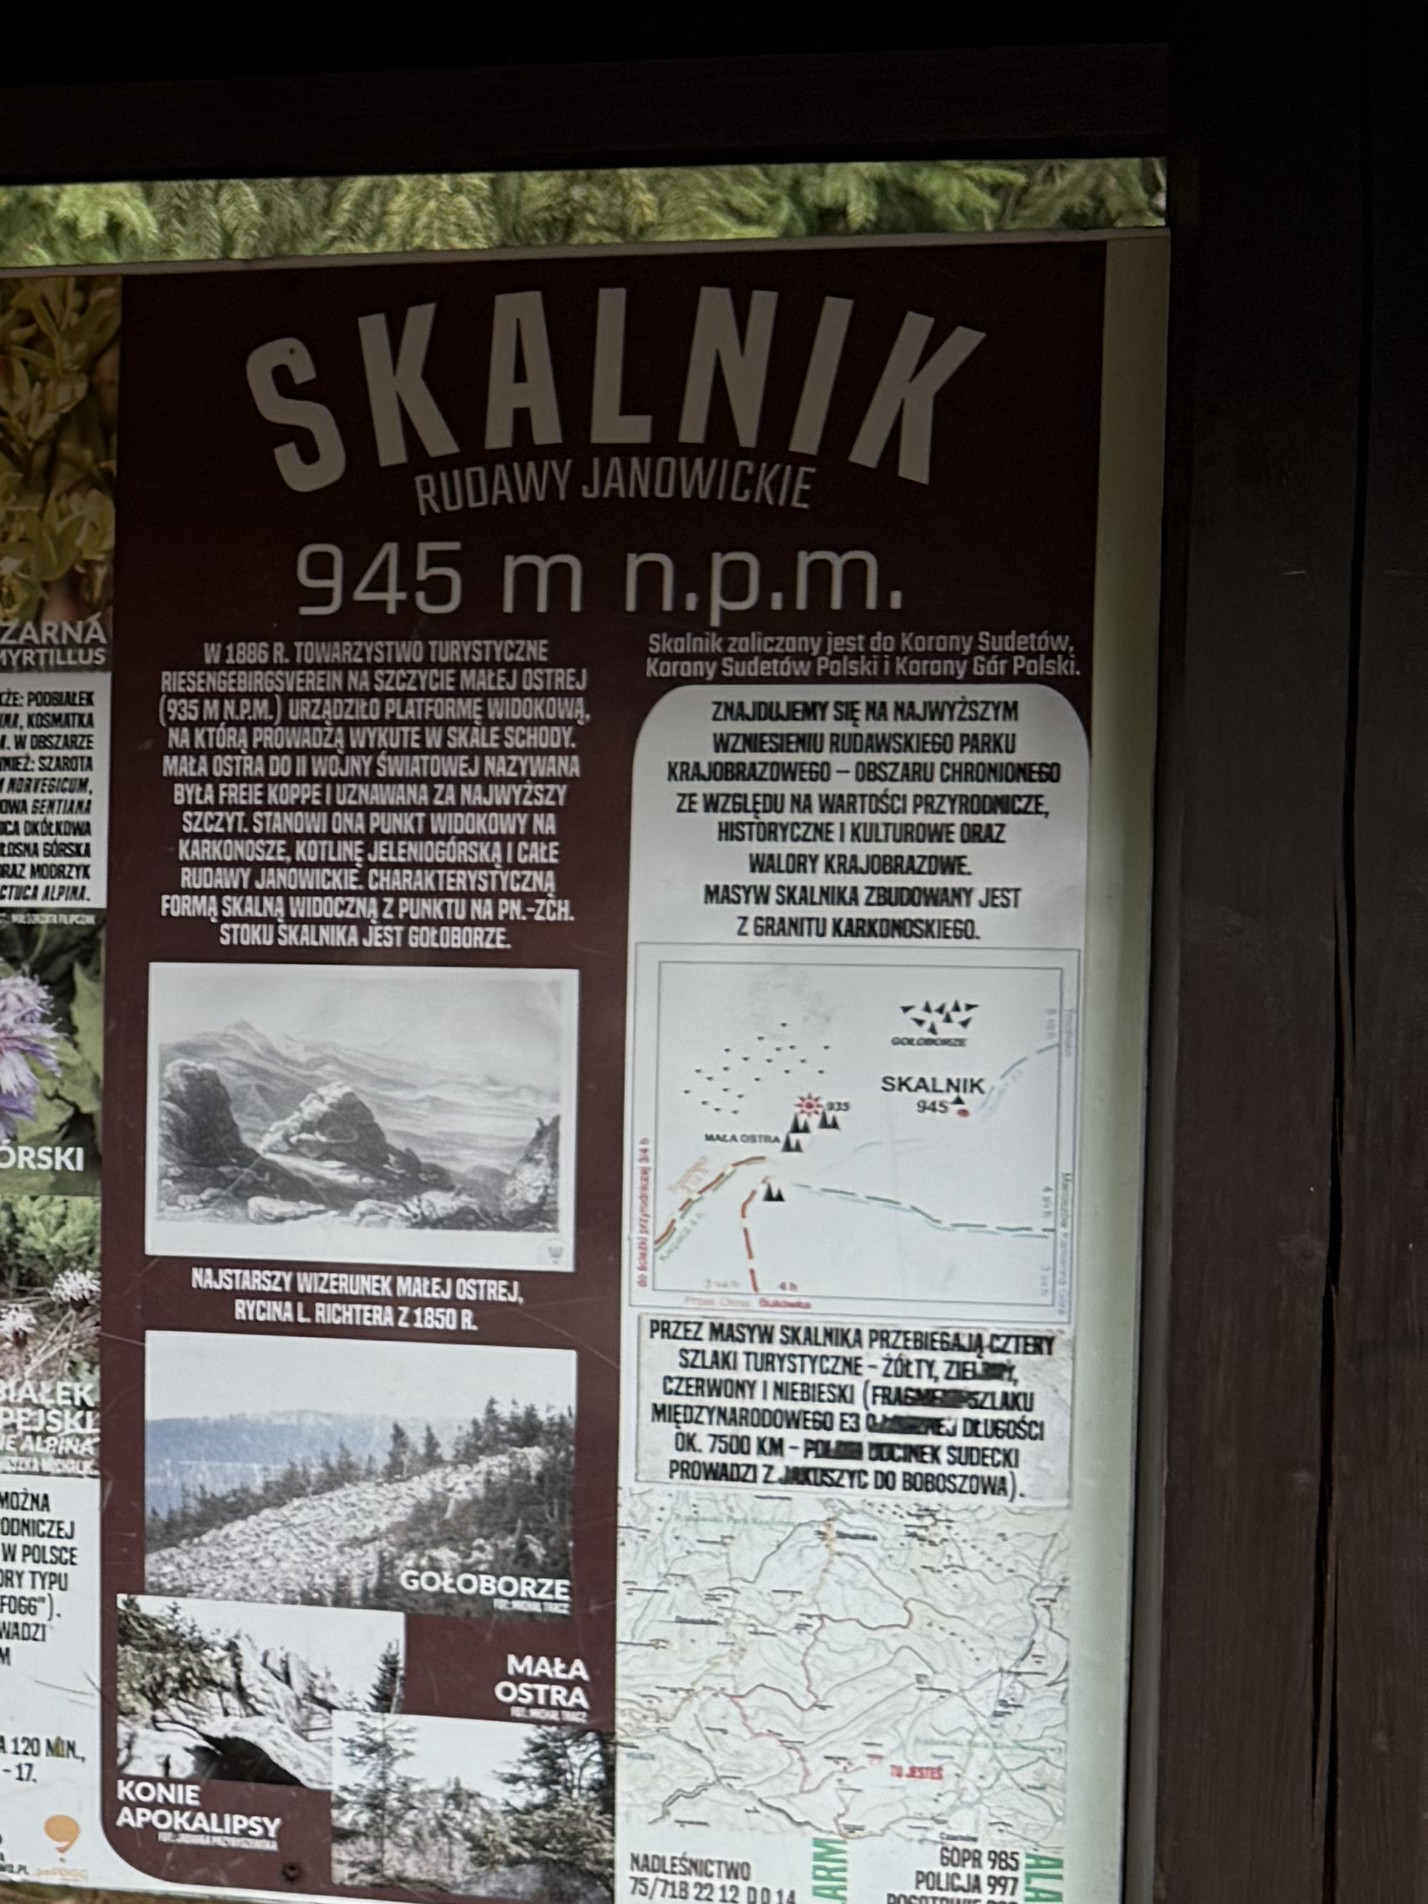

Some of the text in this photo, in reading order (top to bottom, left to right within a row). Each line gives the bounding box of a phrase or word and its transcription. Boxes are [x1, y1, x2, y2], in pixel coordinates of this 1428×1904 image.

[246, 286, 987, 493] SKALNIK
[414, 456, 816, 516] RUDAWY JANOWICKIE
[297, 540, 902, 627] 945 m n.p.m.
[204, 640, 548, 664] W 1886 R. TOWARZYSTWO TURYSTYCZNE
[649, 633, 722, 653] Skalnik
[727, 633, 820, 656] zaliczany
[826, 633, 864, 655] jest
[870, 632, 895, 652] do
[978, 632, 1074, 651] Sudetów,
[722, 657, 810, 677] Sudetów
[817, 657, 878, 676] Polski
[884, 657, 889, 676] i
[973, 656, 1006, 676] Gór
[1014, 656, 1080, 675] Polski.
[162, 669, 587, 692] RIESENGEBIRGSVEREIN NA SZCZYCIE MAŁEJ OSTREJ
[160, 695, 589, 725] (935 M N.P.M.) URZĄDZIŁO PLATFORMĘ WIDOKOWĄ,
[712, 697, 1018, 726] ZNAJDUJEMY SIĘ NA NAJWYŻSZYM
[713, 734, 1016, 753] WZNIESIENIU RUDAWSKIEGO PARKU
[163, 751, 579, 777] MAŁA OSTRA DO II WOJNY ŚWIATOWEJ NAZYWANA
[738, 917, 979, 939] Z GRANITU KARKONOSKIEGO.
[881, 1077, 985, 1093] SKALNIK
[917, 1101, 949, 1113] 945
[192, 1268, 523, 1305] NAJSTARSZY WIZERUNEK MAŁEJ OSTREJ,
[235, 1299, 477, 1330] RYCINA L. RICHTERA Z 1850 R.
[650, 1321, 703, 1341] PRZEZ
[709, 1323, 774, 1344] MASYW
[780, 1326, 863, 1347] SKALNIKA
[990, 1334, 1055, 1355] CZTERY
[400, 1570, 571, 1600] GOŁOBORZE
[507, 1654, 590, 1682] MAŁA
[495, 1682, 590, 1709] OSTRA
[117, 1779, 200, 1807] KONIE
[116, 1807, 281, 1838] APOKALIPSY
[631, 1849, 750, 1881] NADLEŚNICTWO
[941, 1849, 1019, 1870] GOPR 985
[694, 1881, 713, 1902] 22
[719, 1883, 739, 1904] 12
[915, 1872, 1018, 1894] POLICJA 997
